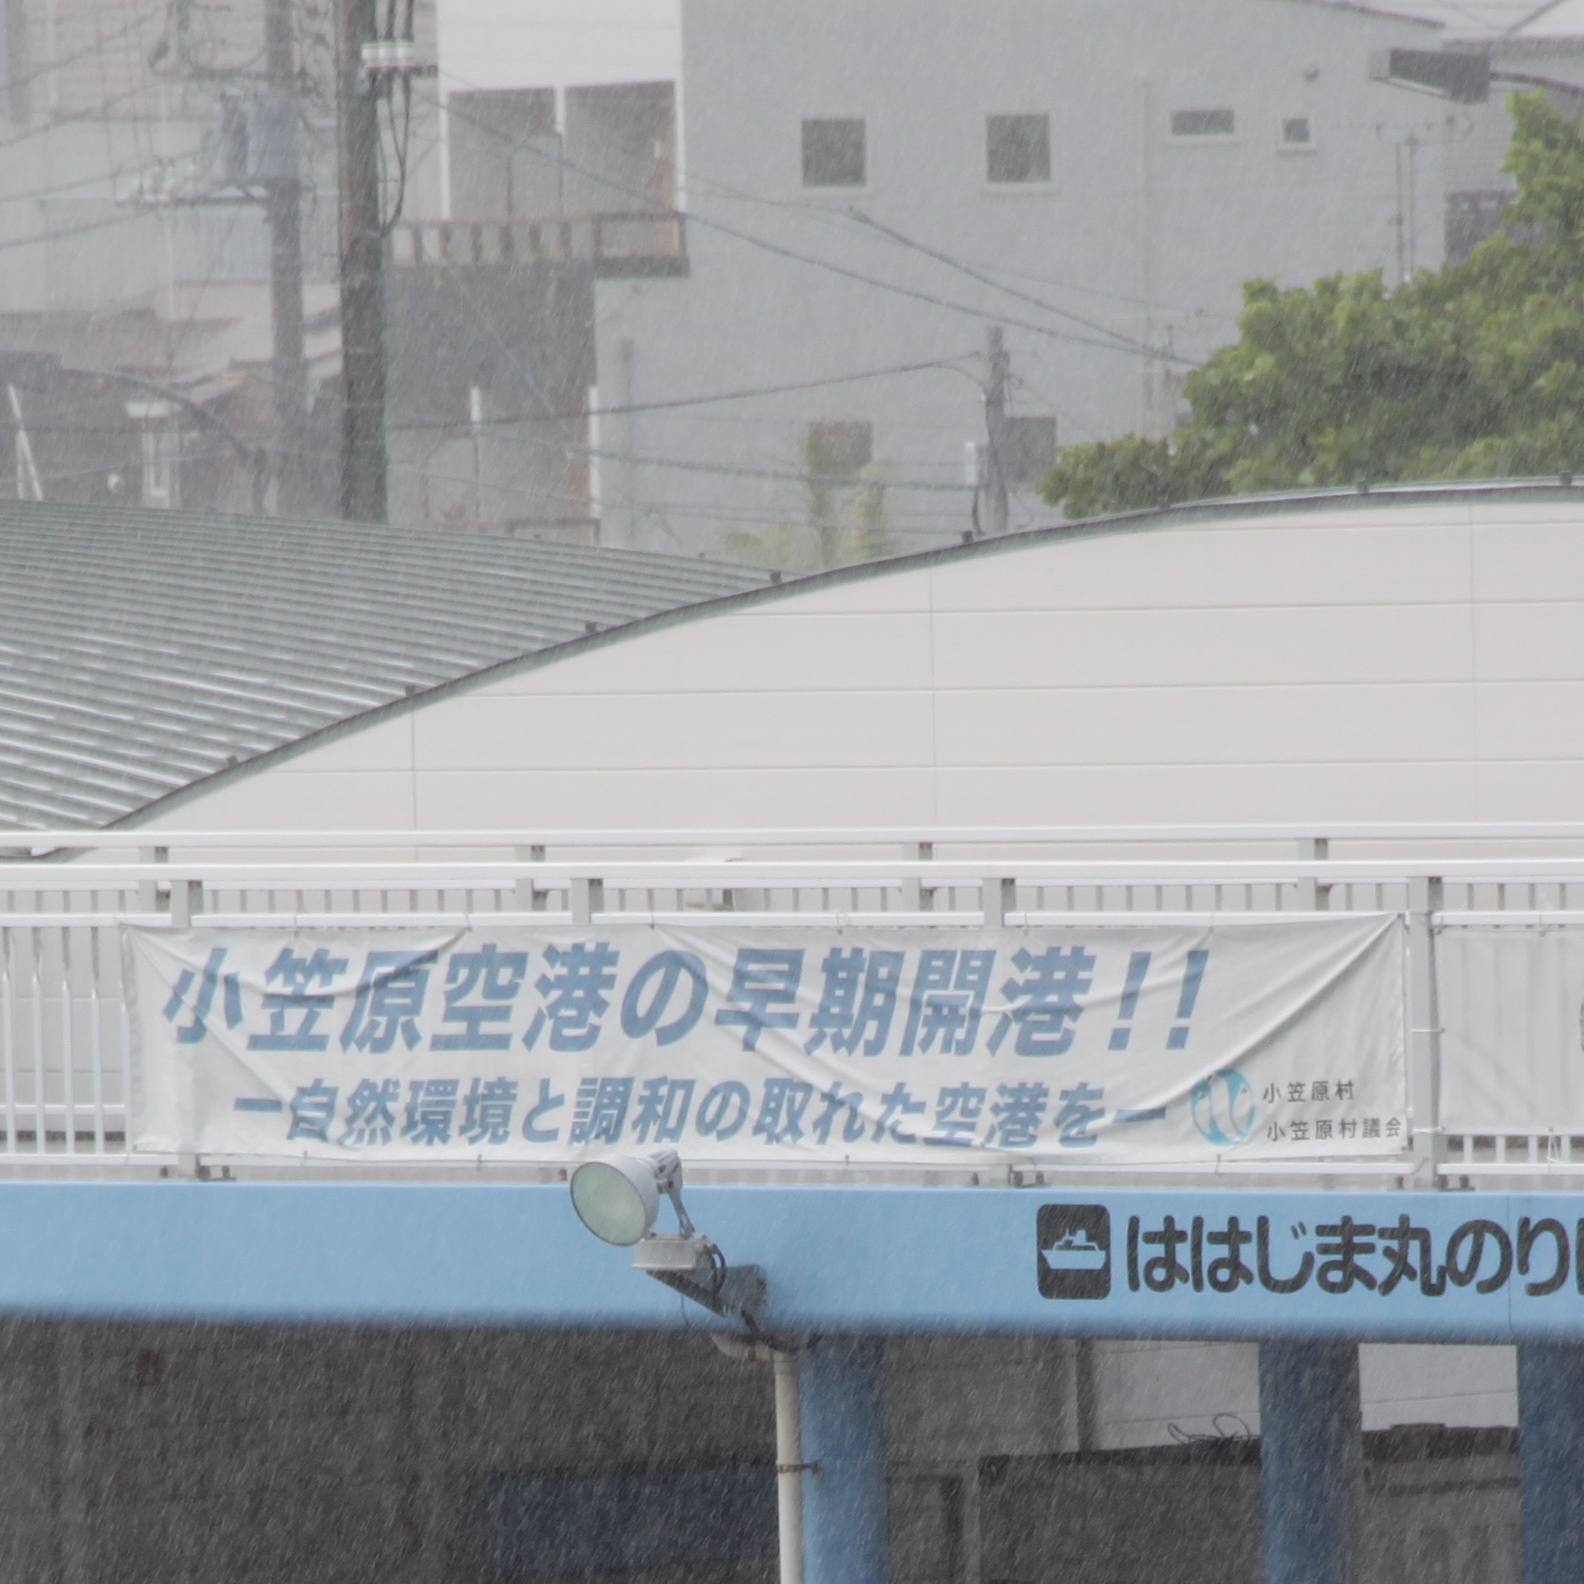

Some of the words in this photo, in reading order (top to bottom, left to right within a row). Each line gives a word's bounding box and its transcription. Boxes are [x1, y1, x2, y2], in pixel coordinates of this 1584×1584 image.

[1263, 1080, 1354, 1104] 小笠原村
[1267, 1117, 1402, 1142] 小笠原村議会
